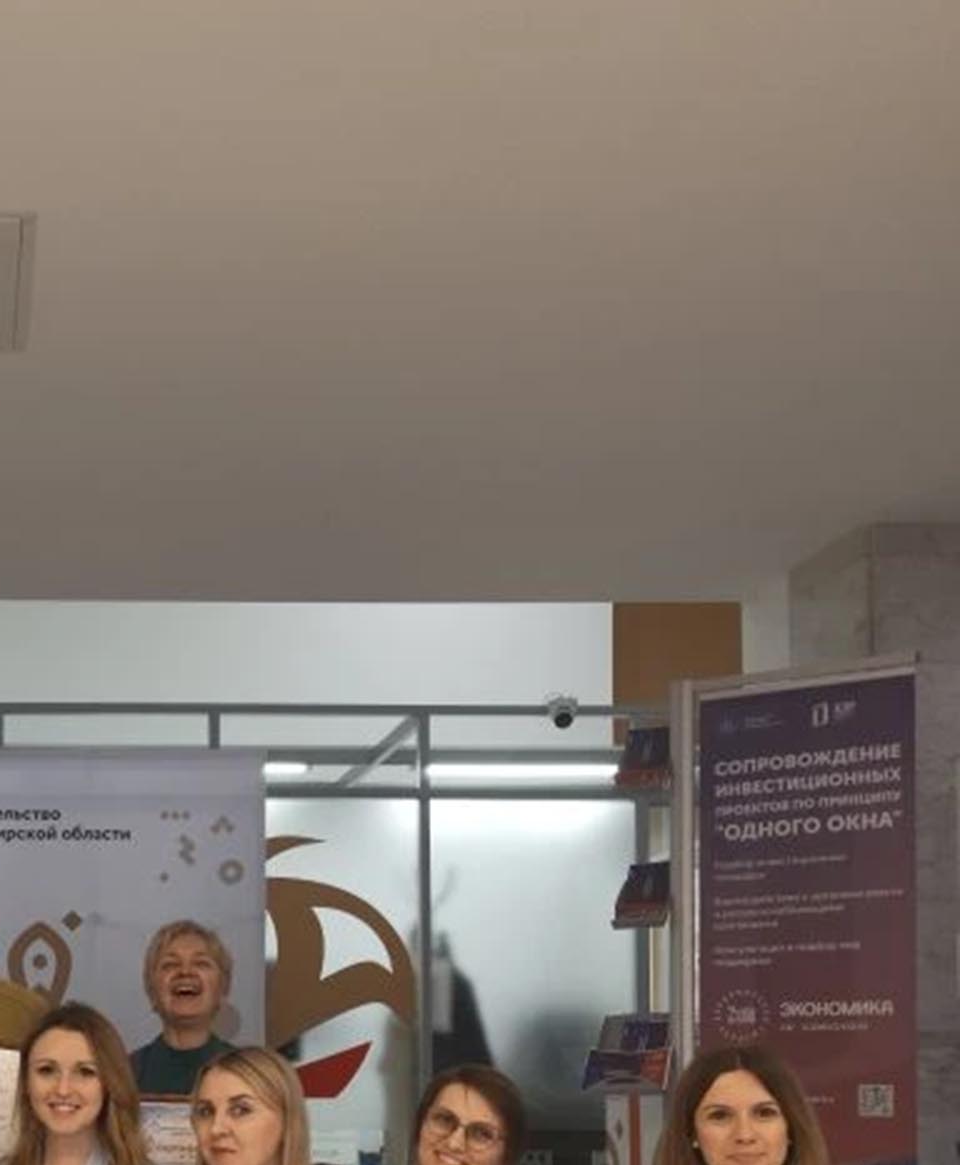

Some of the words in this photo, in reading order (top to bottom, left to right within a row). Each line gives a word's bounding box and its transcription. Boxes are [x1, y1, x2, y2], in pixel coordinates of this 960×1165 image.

[714, 743, 902, 776] СОПРОВОЖДЕНИЕ
[714, 767, 902, 797] ИНВЕСТИЦИОННЫХ
[792, 796, 815, 810] ПО
[61, 823, 132, 841] области
[780, 1000, 894, 1018] ЭКОНОМИКА
